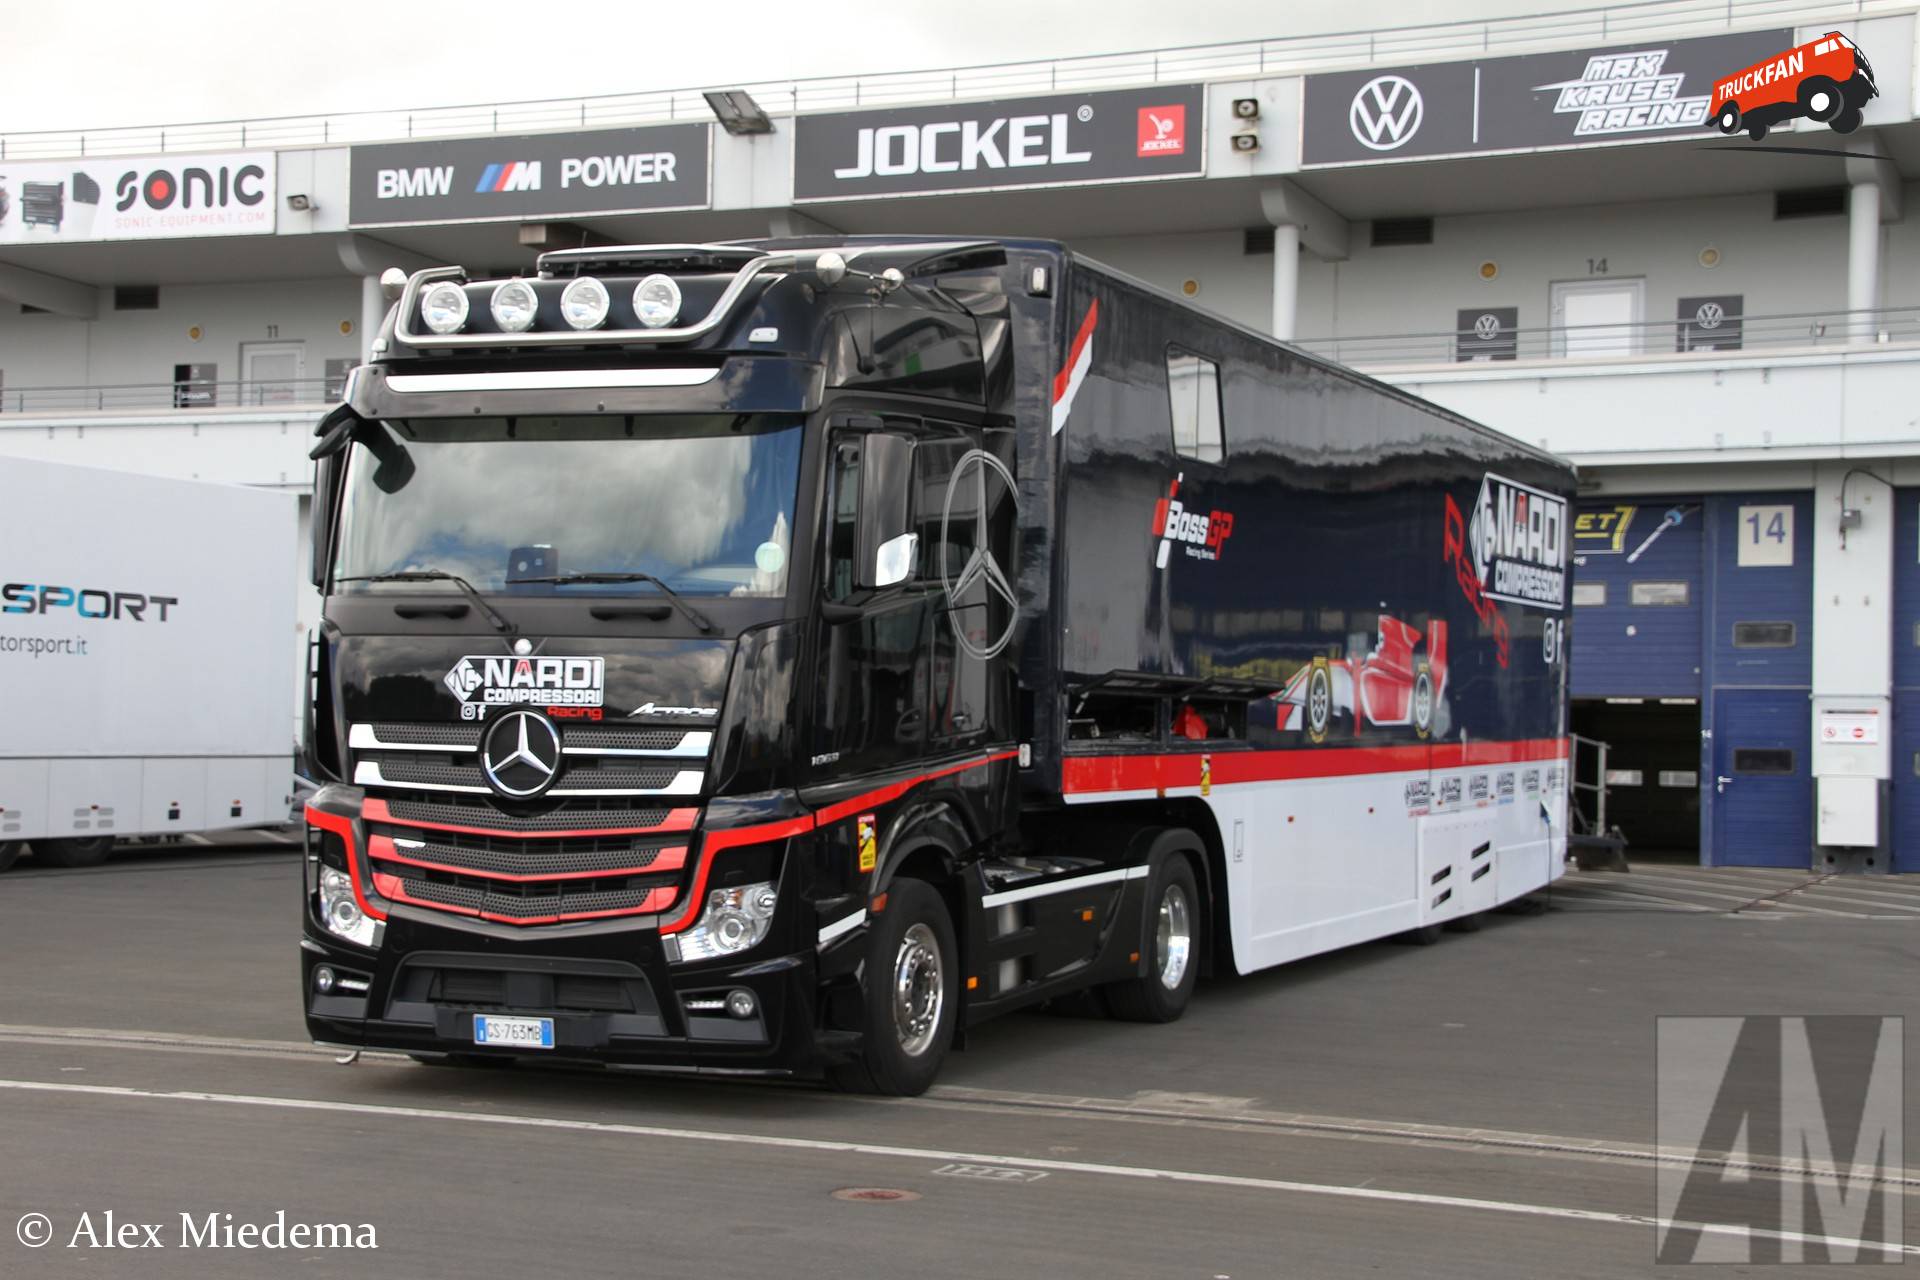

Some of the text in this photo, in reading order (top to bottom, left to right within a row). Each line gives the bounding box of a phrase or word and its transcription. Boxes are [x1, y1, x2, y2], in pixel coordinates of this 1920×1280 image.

[1586, 55, 1661, 82] MAX
[1560, 77, 1678, 109] KRUSE
[1578, 100, 1709, 132] RACING
[834, 113, 1093, 179] JOCKEL
[377, 166, 454, 198] BMW
[560, 152, 676, 189] POWER
[1586, 257, 1609, 276] 14
[266, 324, 279, 338] 11
[1497, 484, 1566, 570] NARDI
[1746, 511, 1787, 545] 14
[2, 583, 178, 622] SPORT
[484, 658, 601, 689] NARDI
[483, 688, 601, 703] COMPRESSORI
[547, 706, 603, 721] Racing
